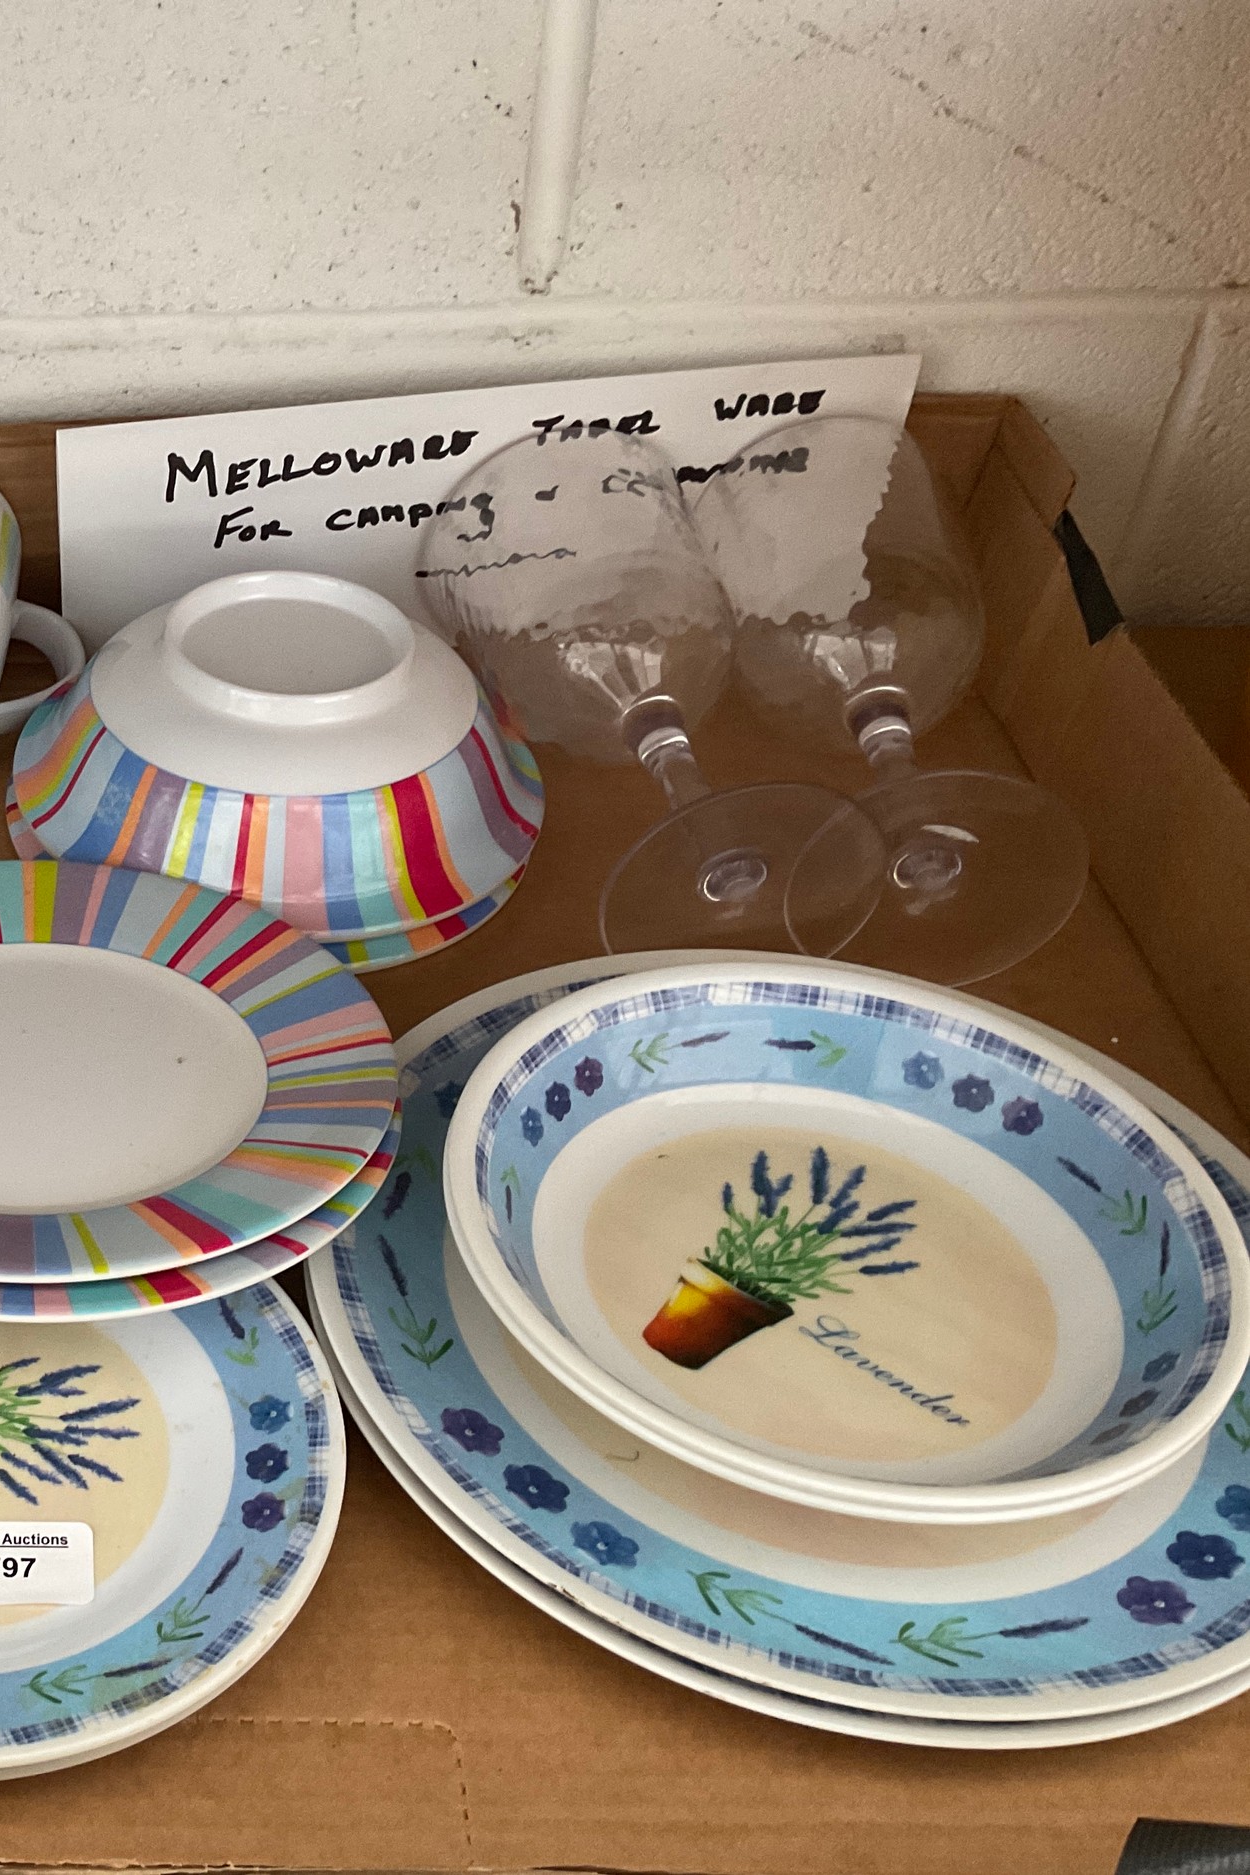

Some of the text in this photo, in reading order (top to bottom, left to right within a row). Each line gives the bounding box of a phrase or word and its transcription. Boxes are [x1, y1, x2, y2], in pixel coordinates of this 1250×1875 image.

[165, 430, 480, 503] MELLOWARE
[714, 388, 827, 421] WARE
[797, 1313, 971, 1429] Lavender
[1, 1532, 69, 1546] Auctions
